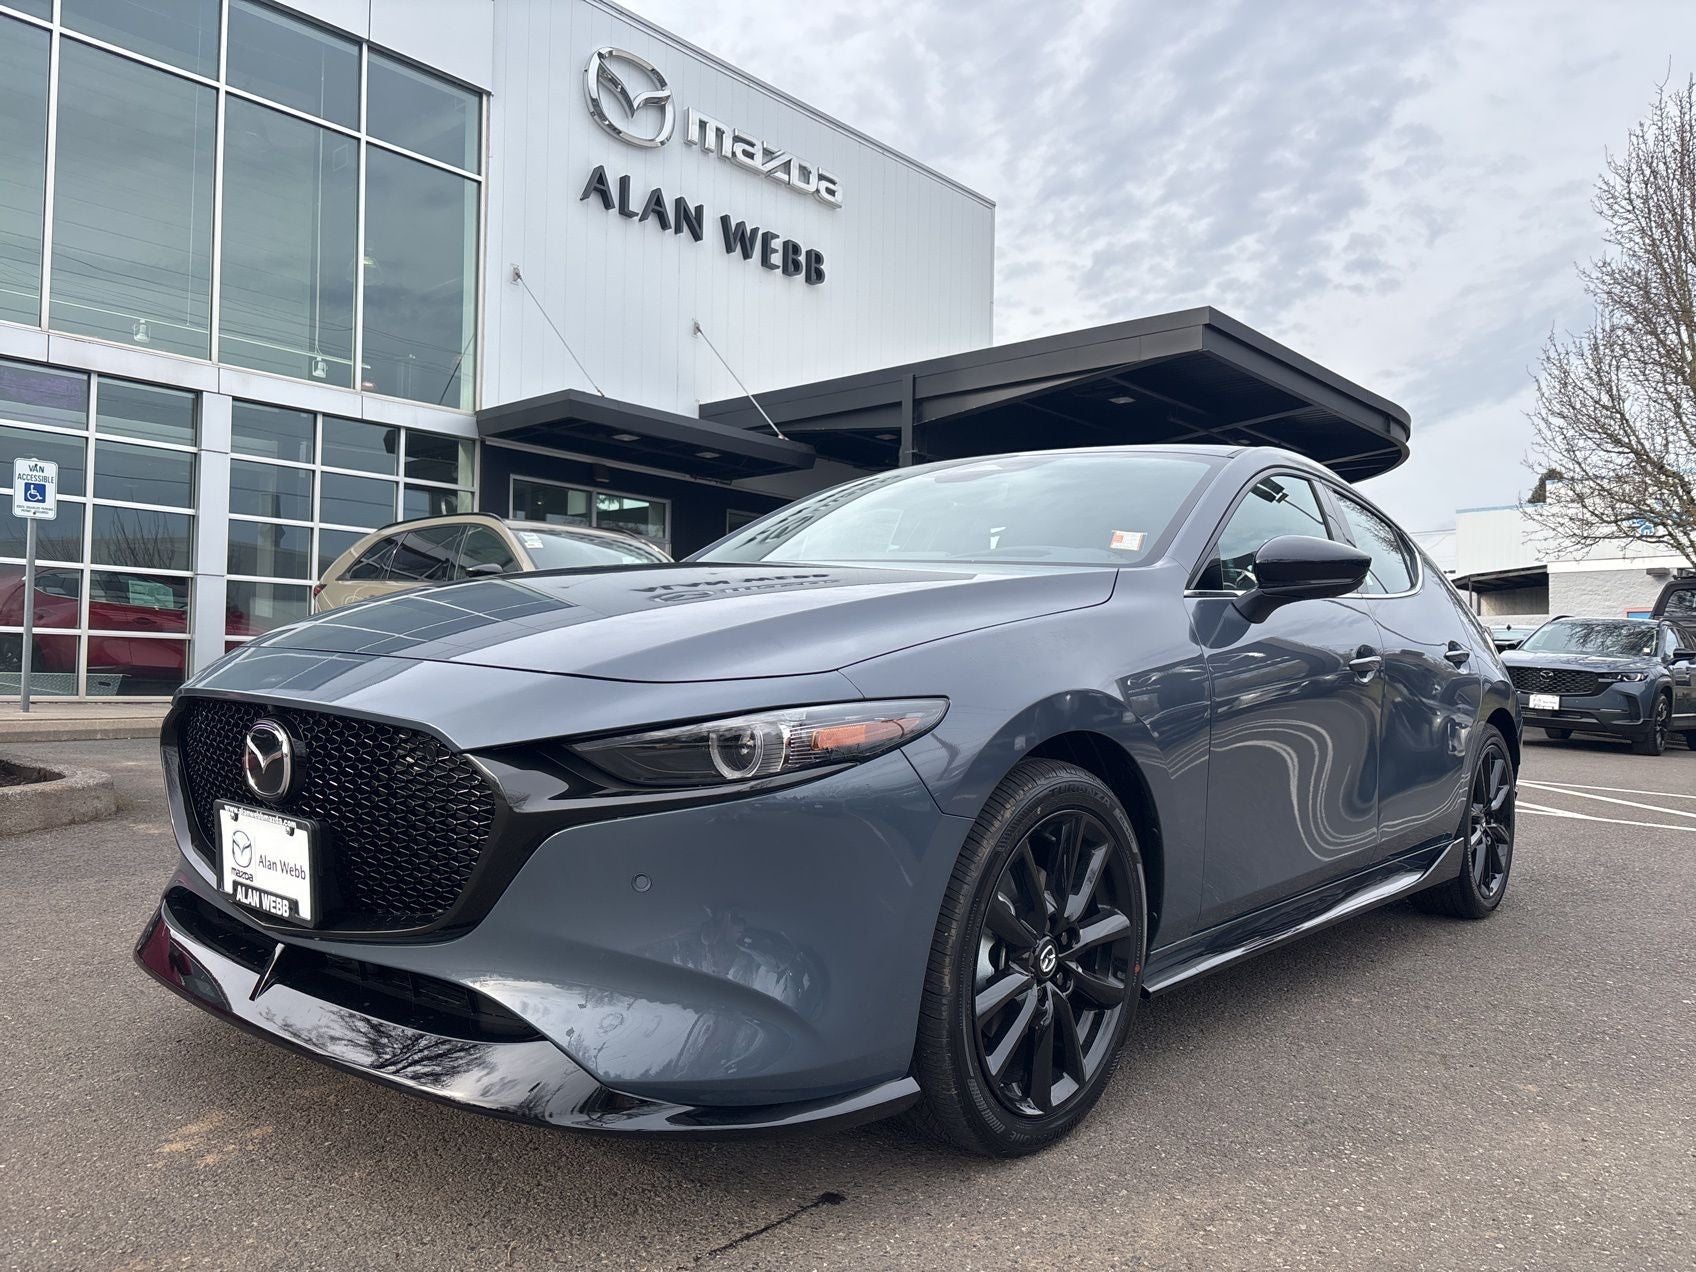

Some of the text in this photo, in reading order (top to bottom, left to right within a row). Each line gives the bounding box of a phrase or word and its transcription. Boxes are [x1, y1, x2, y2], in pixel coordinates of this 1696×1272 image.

[683, 106, 844, 210] mazda
[579, 164, 827, 286] ALAN WEBB
[17, 473, 55, 484] ACCESSIBLE
[28, 464, 45, 473] VAN
[1048, 783, 1110, 808] TURANZA
[231, 867, 254, 882] mazda
[258, 854, 307, 880] Alan Webb
[236, 885, 290, 918] ALAN WEBB
